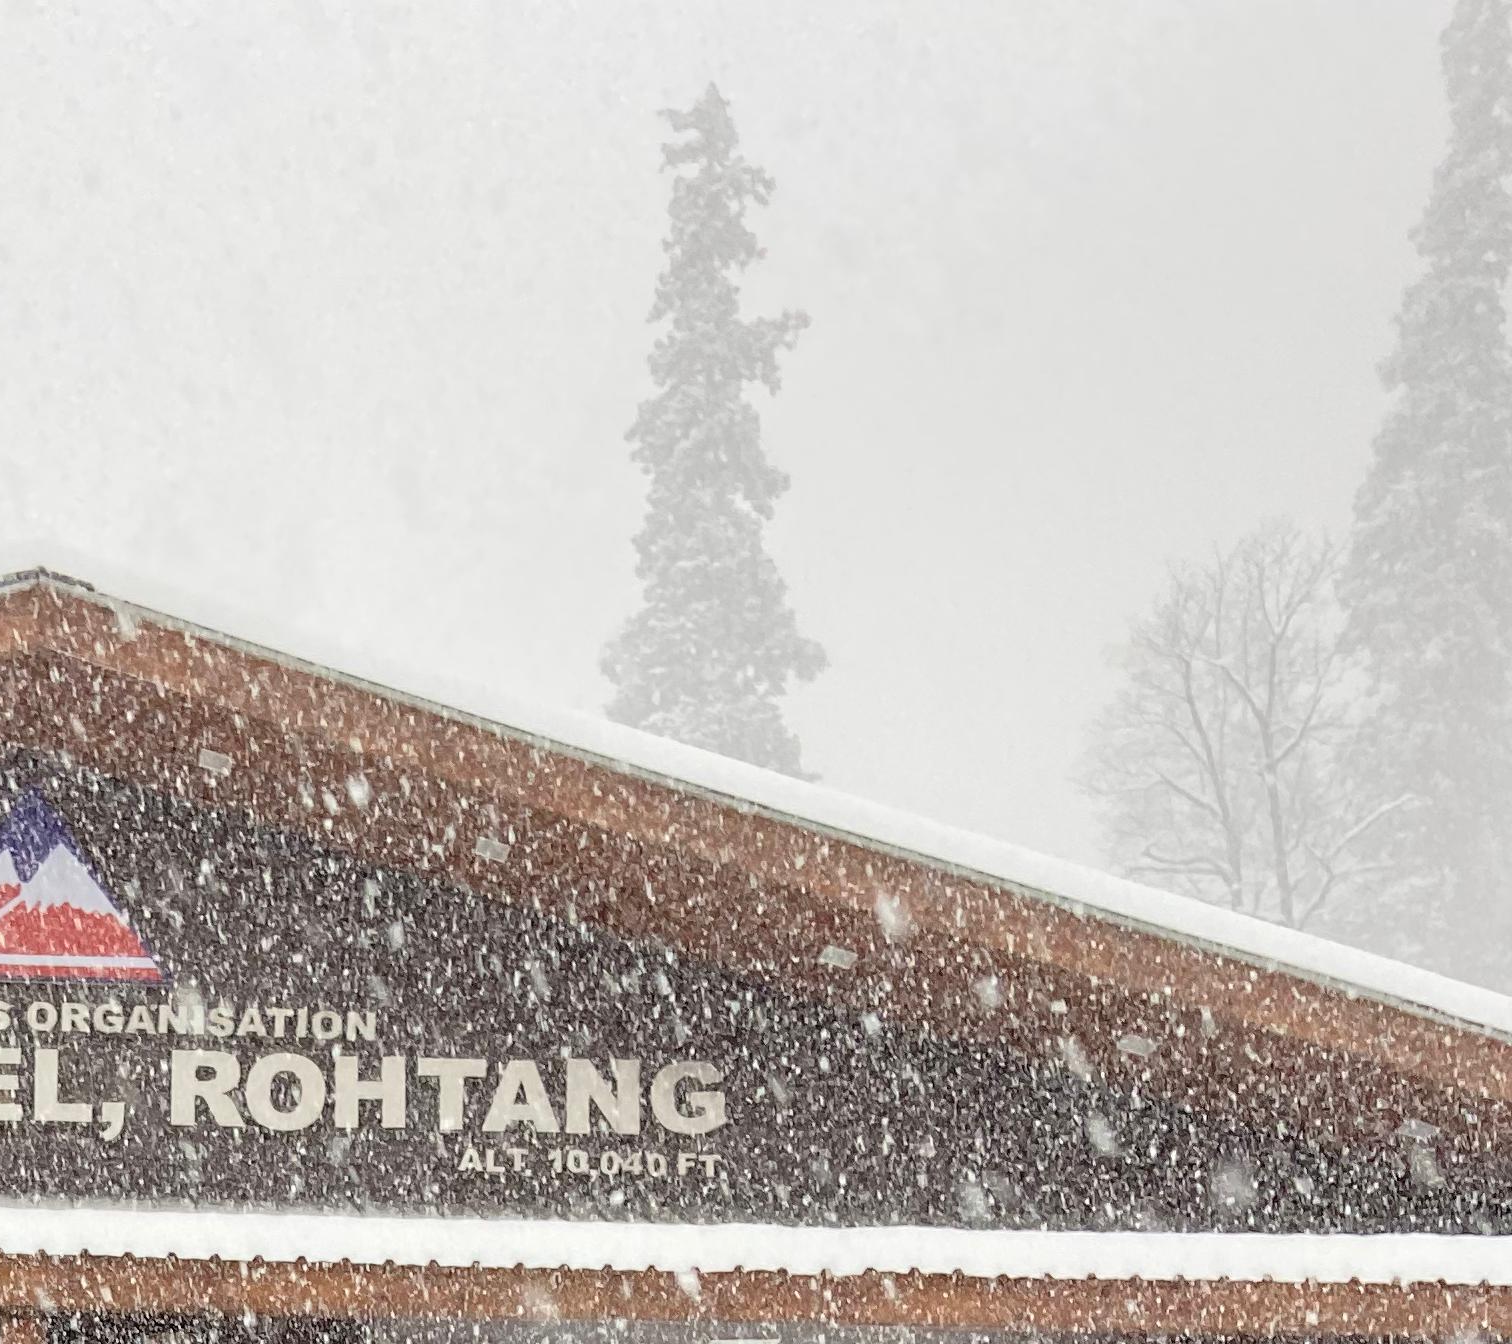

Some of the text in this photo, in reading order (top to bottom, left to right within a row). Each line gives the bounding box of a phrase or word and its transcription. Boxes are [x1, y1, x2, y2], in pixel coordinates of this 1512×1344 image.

[26, 1001, 377, 1042] ORGANISATION
[169, 1047, 729, 1137] ROHTANG
[548, 1148, 668, 1183] 10,040
[677, 1152, 720, 1178] FT
